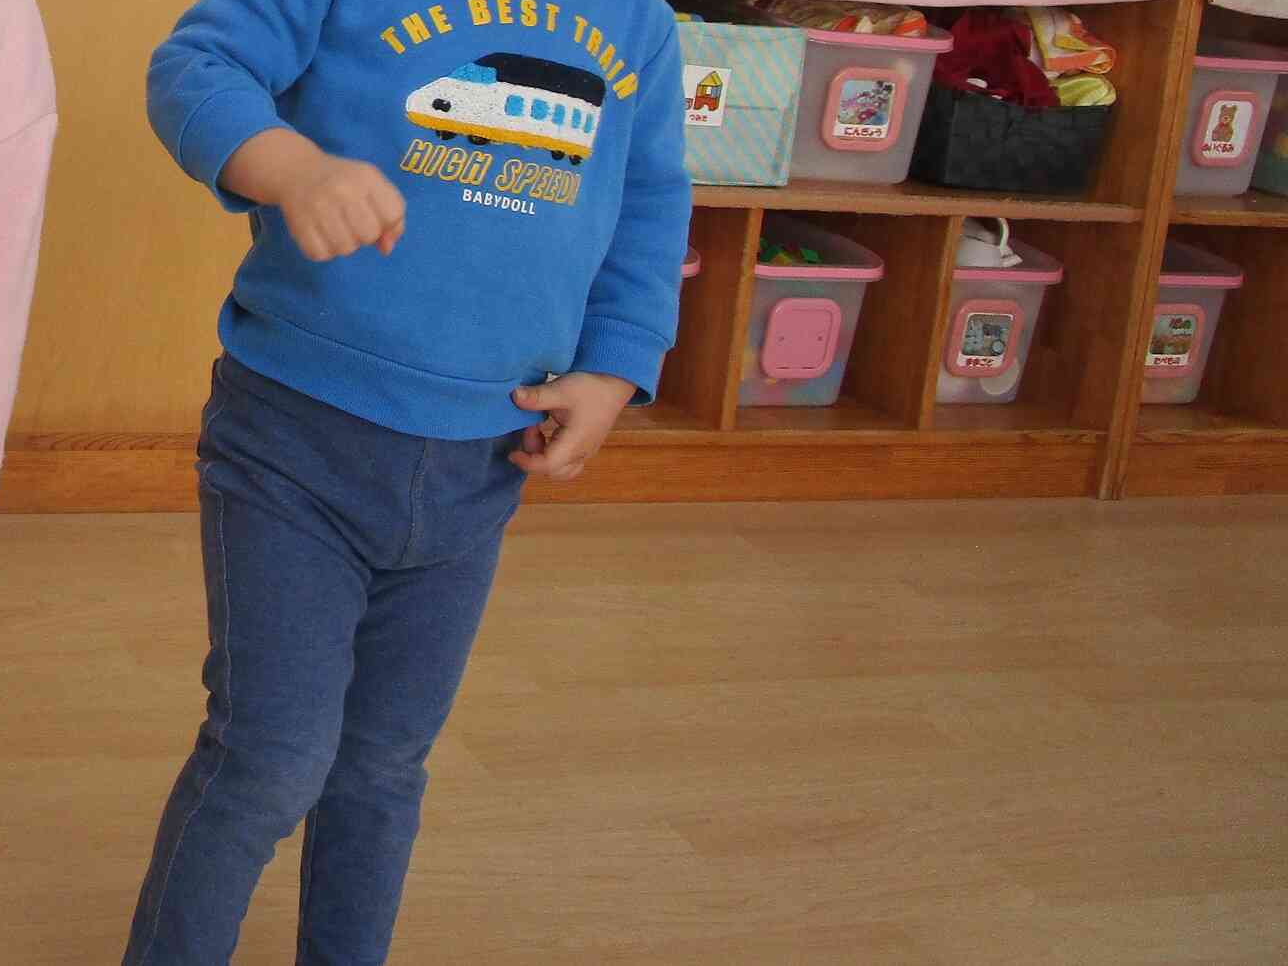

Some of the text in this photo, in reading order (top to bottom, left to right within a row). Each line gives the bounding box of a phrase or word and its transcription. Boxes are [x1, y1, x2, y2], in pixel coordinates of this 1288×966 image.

[379, 4, 453, 55] THE
[574, 15, 639, 100] TRAIN
[400, 138, 582, 206] HIGH SPEED!
[462, 189, 536, 215] BABYDOLL
